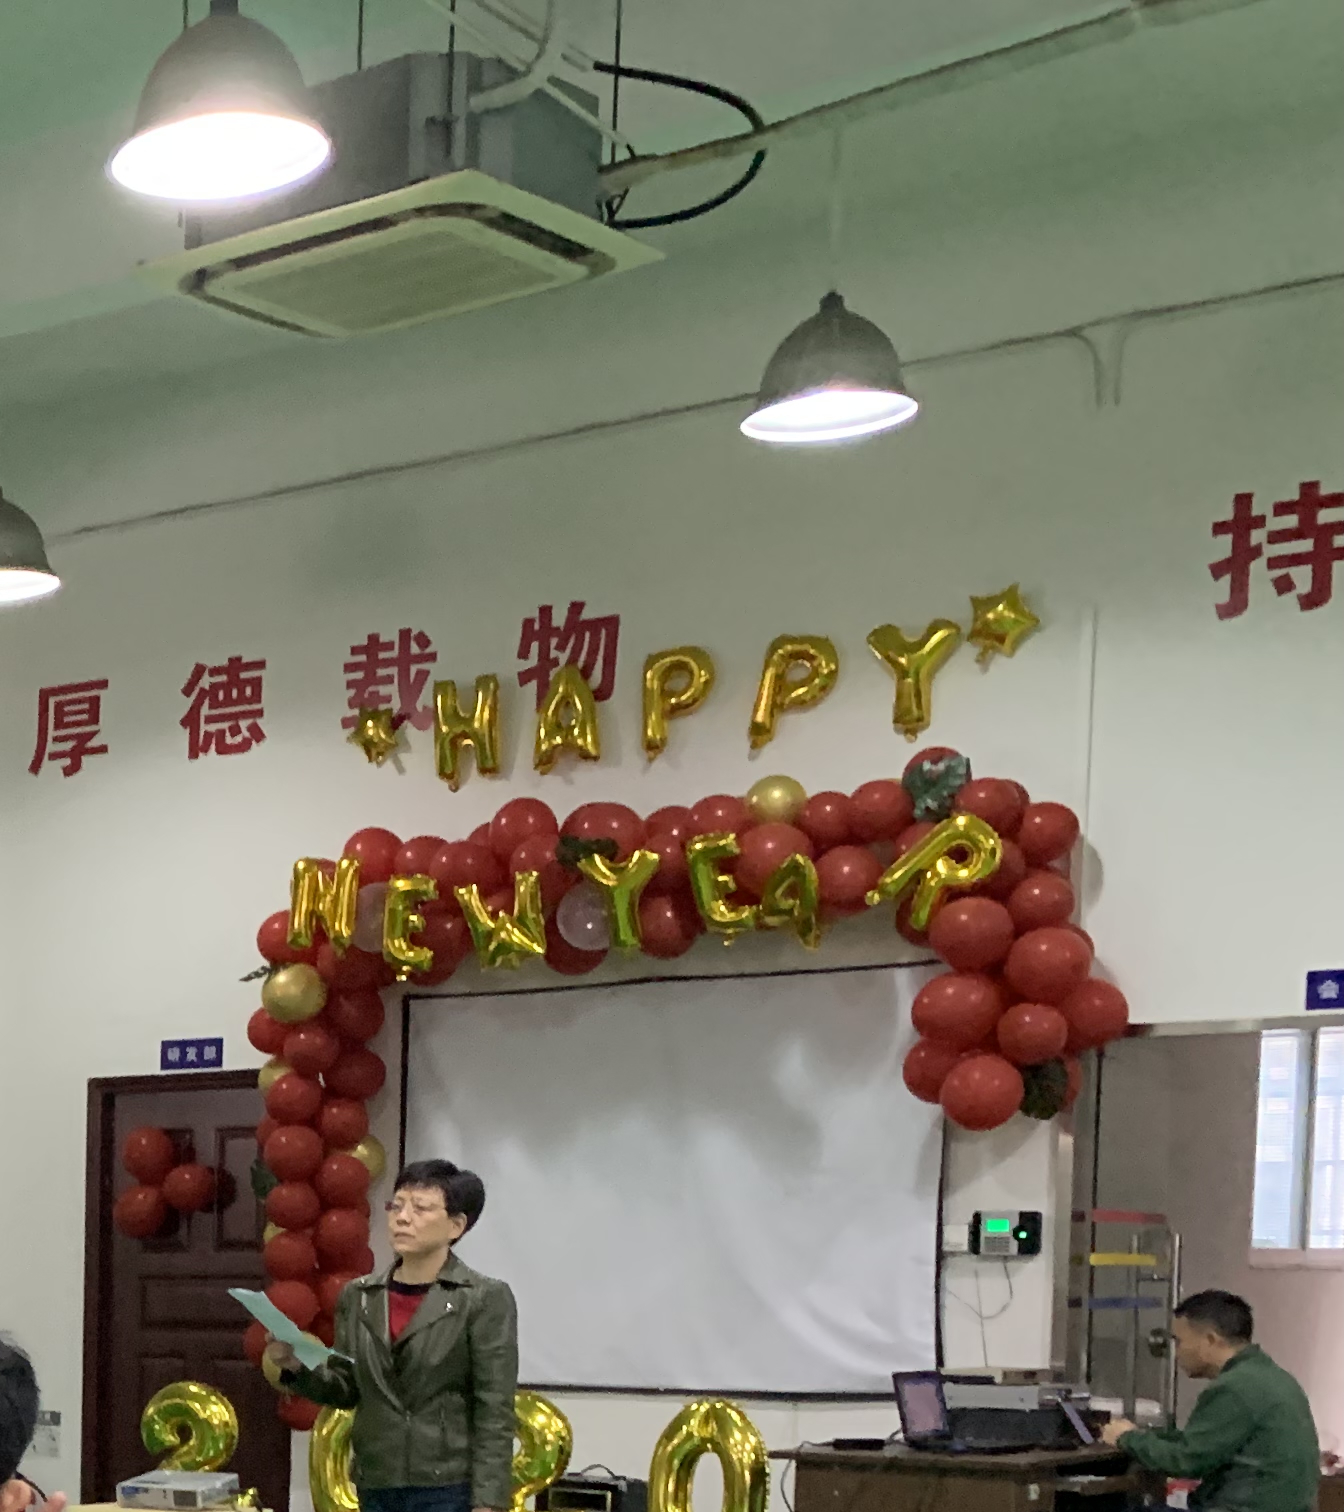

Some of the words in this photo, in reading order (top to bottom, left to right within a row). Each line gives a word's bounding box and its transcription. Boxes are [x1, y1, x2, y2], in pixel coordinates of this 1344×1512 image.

[1208, 480, 1344, 620] 持
[28, 601, 620, 777] 厚德载物
[433, 618, 961, 790] HAPPY
